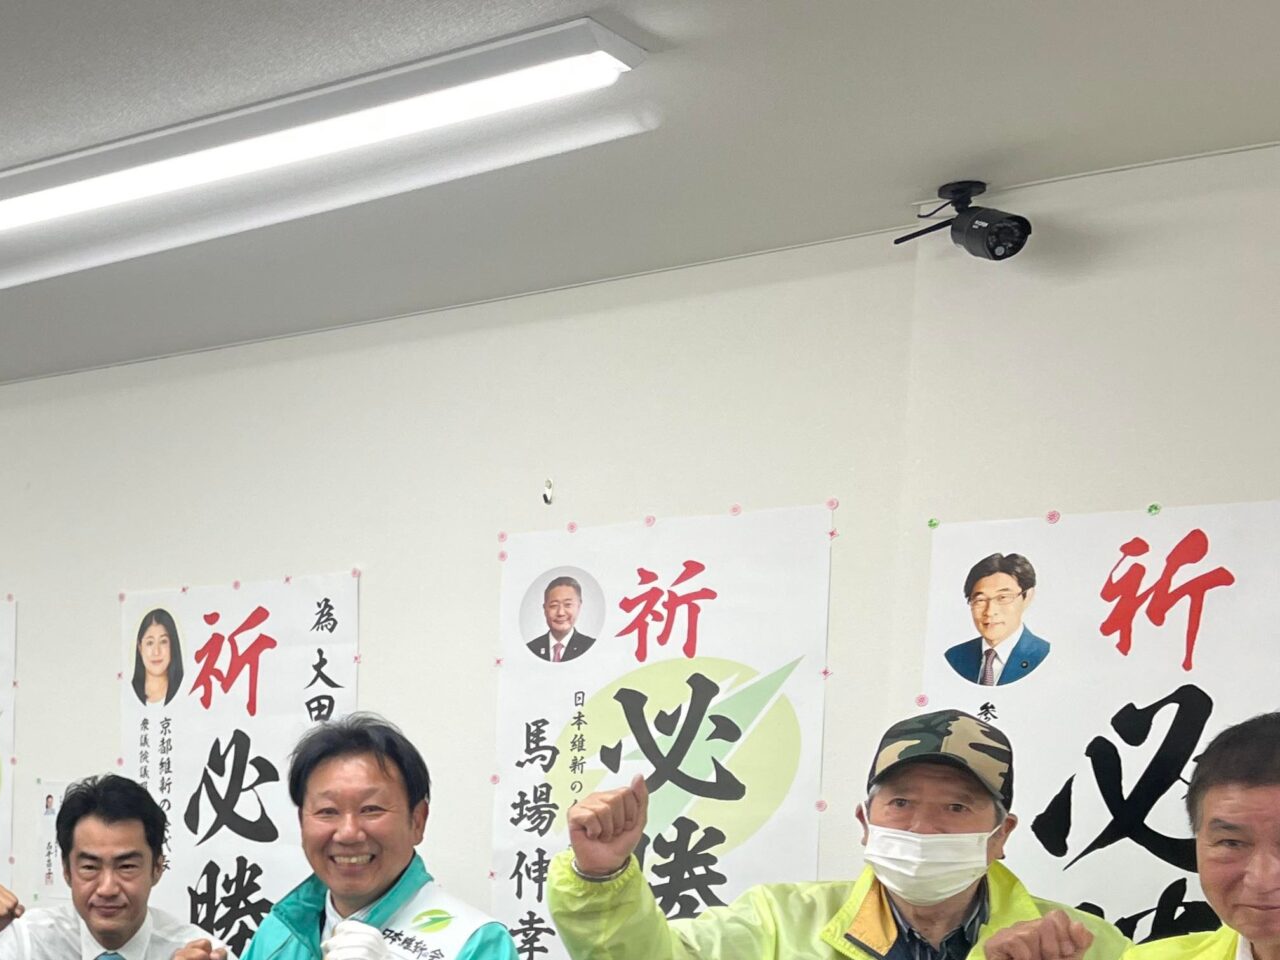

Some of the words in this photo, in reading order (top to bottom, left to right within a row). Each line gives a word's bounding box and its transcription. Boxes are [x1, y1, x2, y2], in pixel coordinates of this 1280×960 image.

[569, 690, 588, 807] 日本維新の
